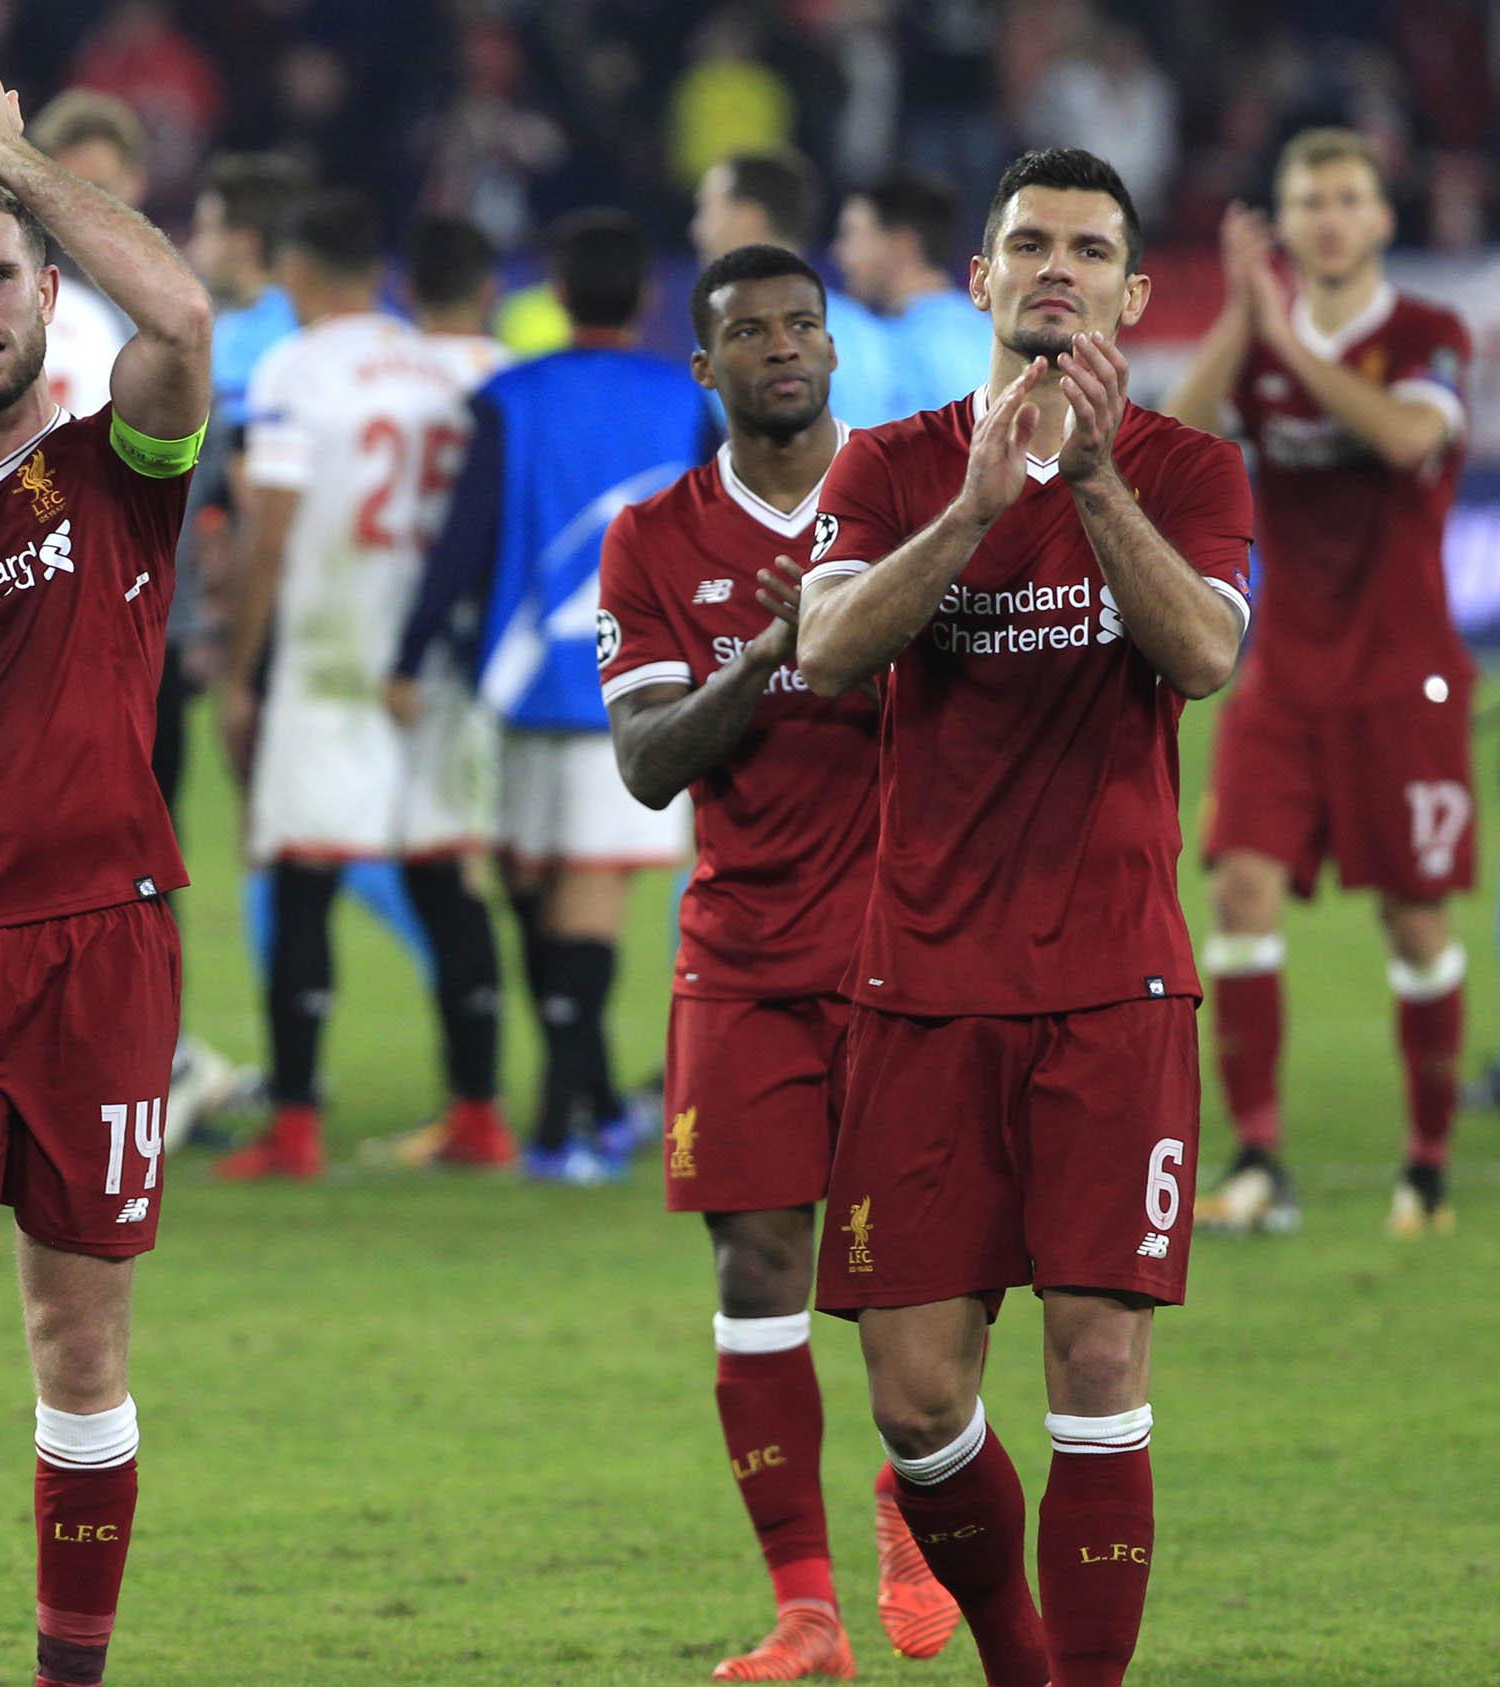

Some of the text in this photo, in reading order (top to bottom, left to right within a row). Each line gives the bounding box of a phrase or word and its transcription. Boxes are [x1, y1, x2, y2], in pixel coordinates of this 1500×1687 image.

[939, 577, 1090, 614] Standard
[933, 616, 1089, 653] Chartered
[101, 1097, 162, 1194] 14
[1145, 1138, 1184, 1230] 6
